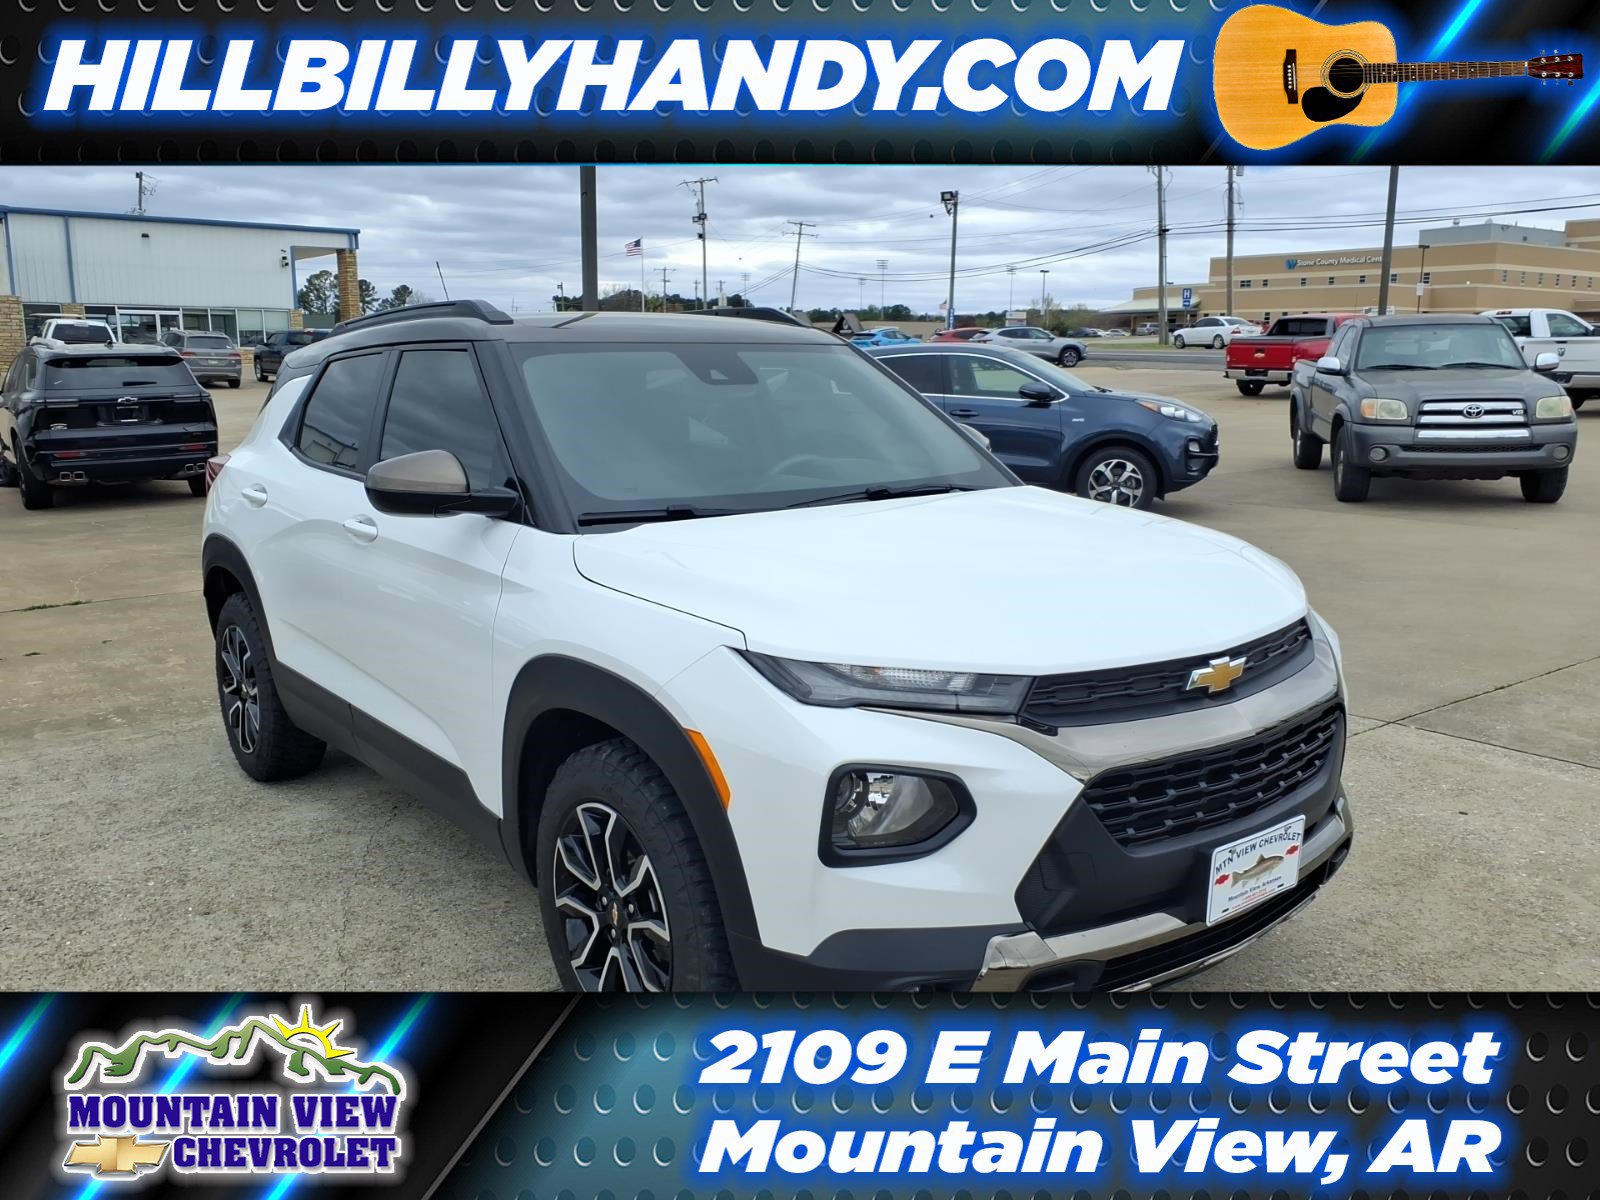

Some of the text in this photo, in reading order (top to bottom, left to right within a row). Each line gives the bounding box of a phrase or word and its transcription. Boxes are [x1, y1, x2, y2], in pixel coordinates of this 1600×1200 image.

[1316, 258, 1338, 266] County
[1339, 256, 1365, 264] Medical
[1366, 255, 1383, 263] Cent
[1183, 289, 1191, 299] H
[1236, 843, 1257, 859] VIEW
[1258, 833, 1301, 848] CHEVROLET
